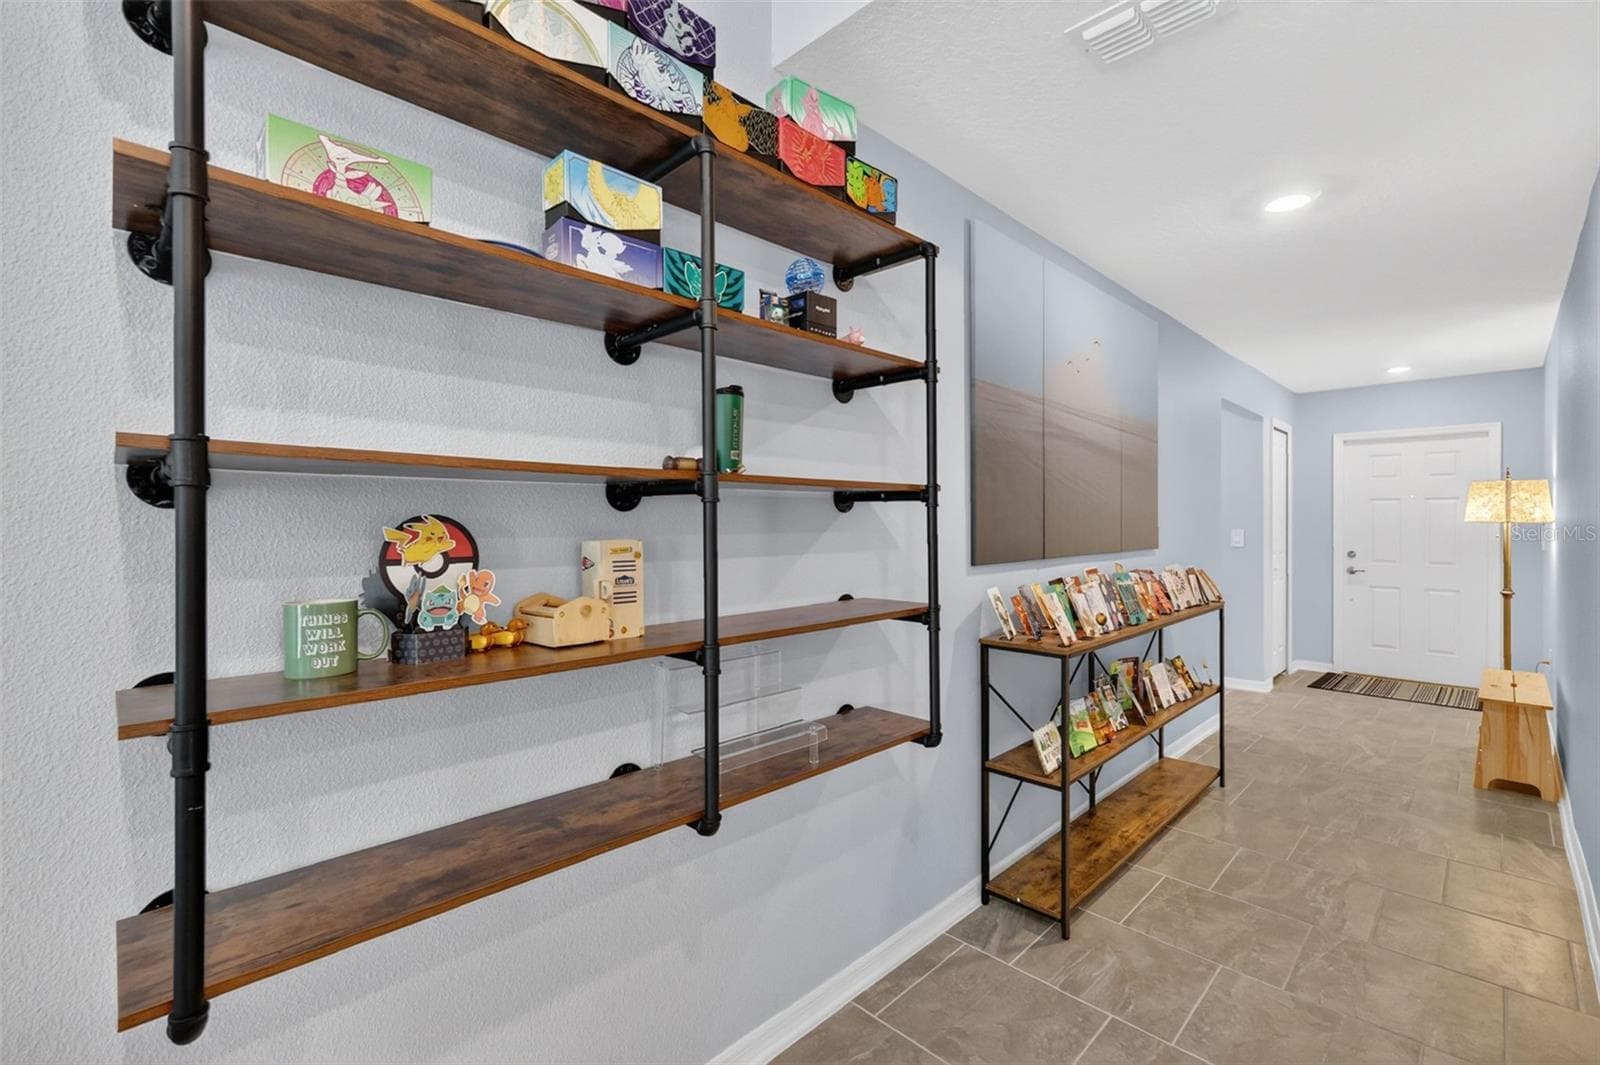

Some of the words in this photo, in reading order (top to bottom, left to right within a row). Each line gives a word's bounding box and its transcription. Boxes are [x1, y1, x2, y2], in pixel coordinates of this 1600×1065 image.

[301, 613, 348, 627] THINGS
[305, 627, 344, 641] WILL
[303, 640, 346, 656] WORK
[312, 655, 340, 669] OUT
